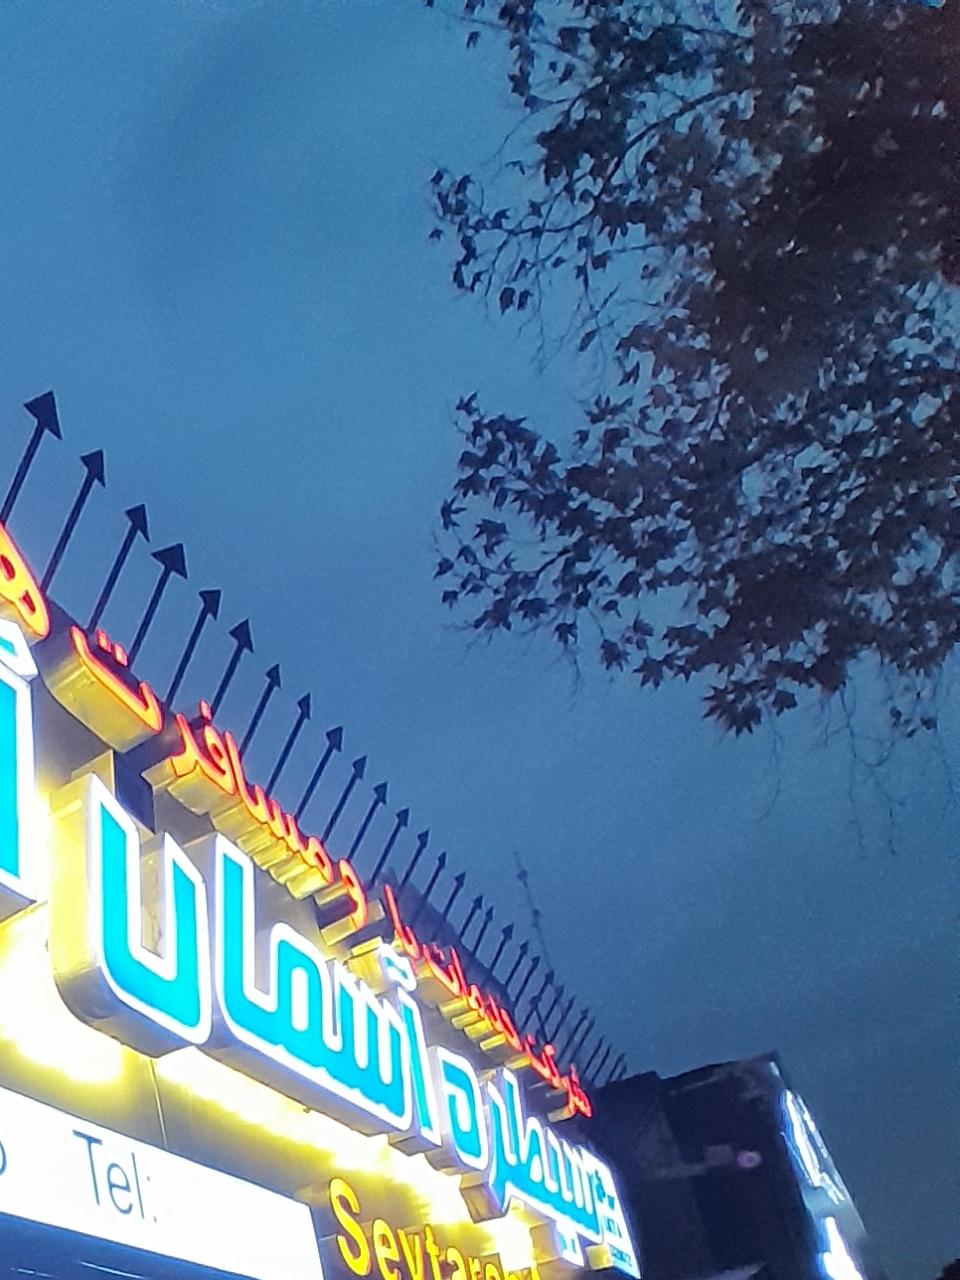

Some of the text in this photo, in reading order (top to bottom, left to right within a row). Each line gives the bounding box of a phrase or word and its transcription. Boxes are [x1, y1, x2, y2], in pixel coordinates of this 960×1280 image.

[70, 625, 334, 884] مسافرت
[84, 752, 443, 1147] آسمان
[72, 1129, 158, 1222] Tel:
